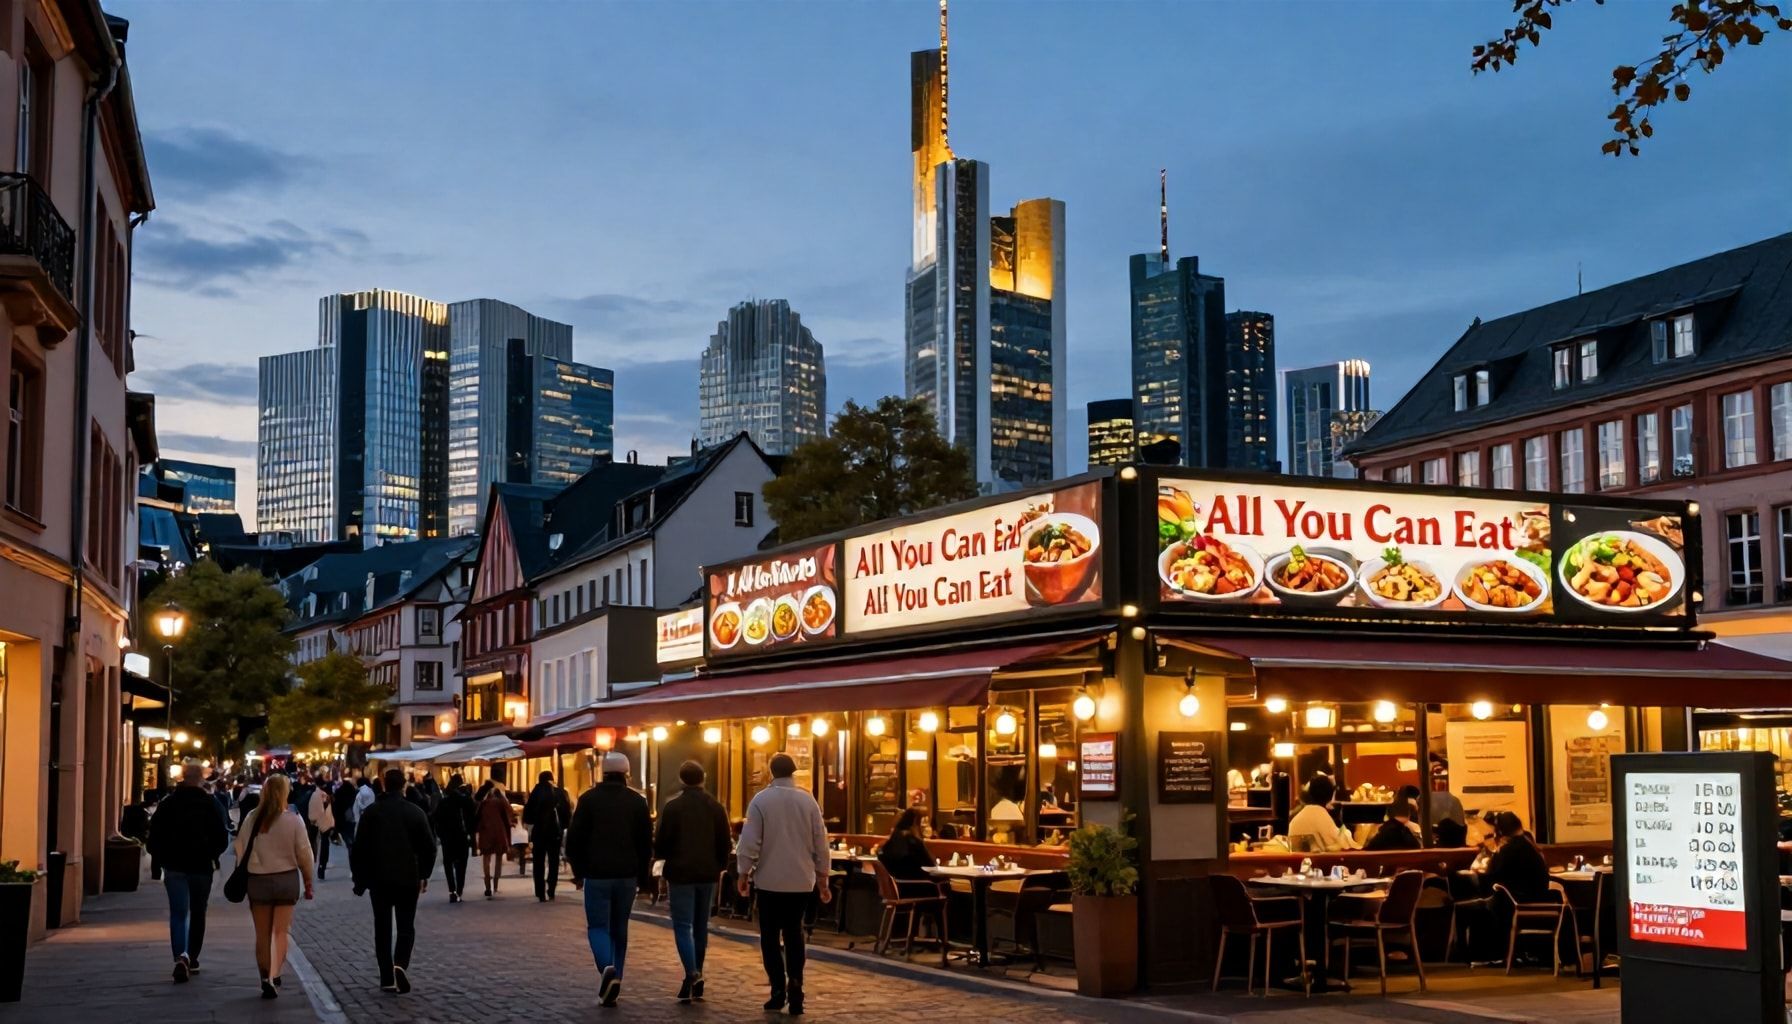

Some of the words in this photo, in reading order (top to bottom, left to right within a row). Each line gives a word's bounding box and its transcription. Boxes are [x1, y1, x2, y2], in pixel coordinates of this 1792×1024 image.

[1204, 494, 1264, 536] All
[1274, 499, 1352, 541] You
[1364, 503, 1441, 546] Can
[1454, 510, 1514, 550] Eat
[855, 542, 884, 579] All
[890, 539, 932, 571] You
[941, 528, 986, 562] Can
[864, 585, 888, 616] All
[894, 583, 928, 612] You
[934, 576, 972, 607] Can
[979, 568, 1012, 599] Eat
